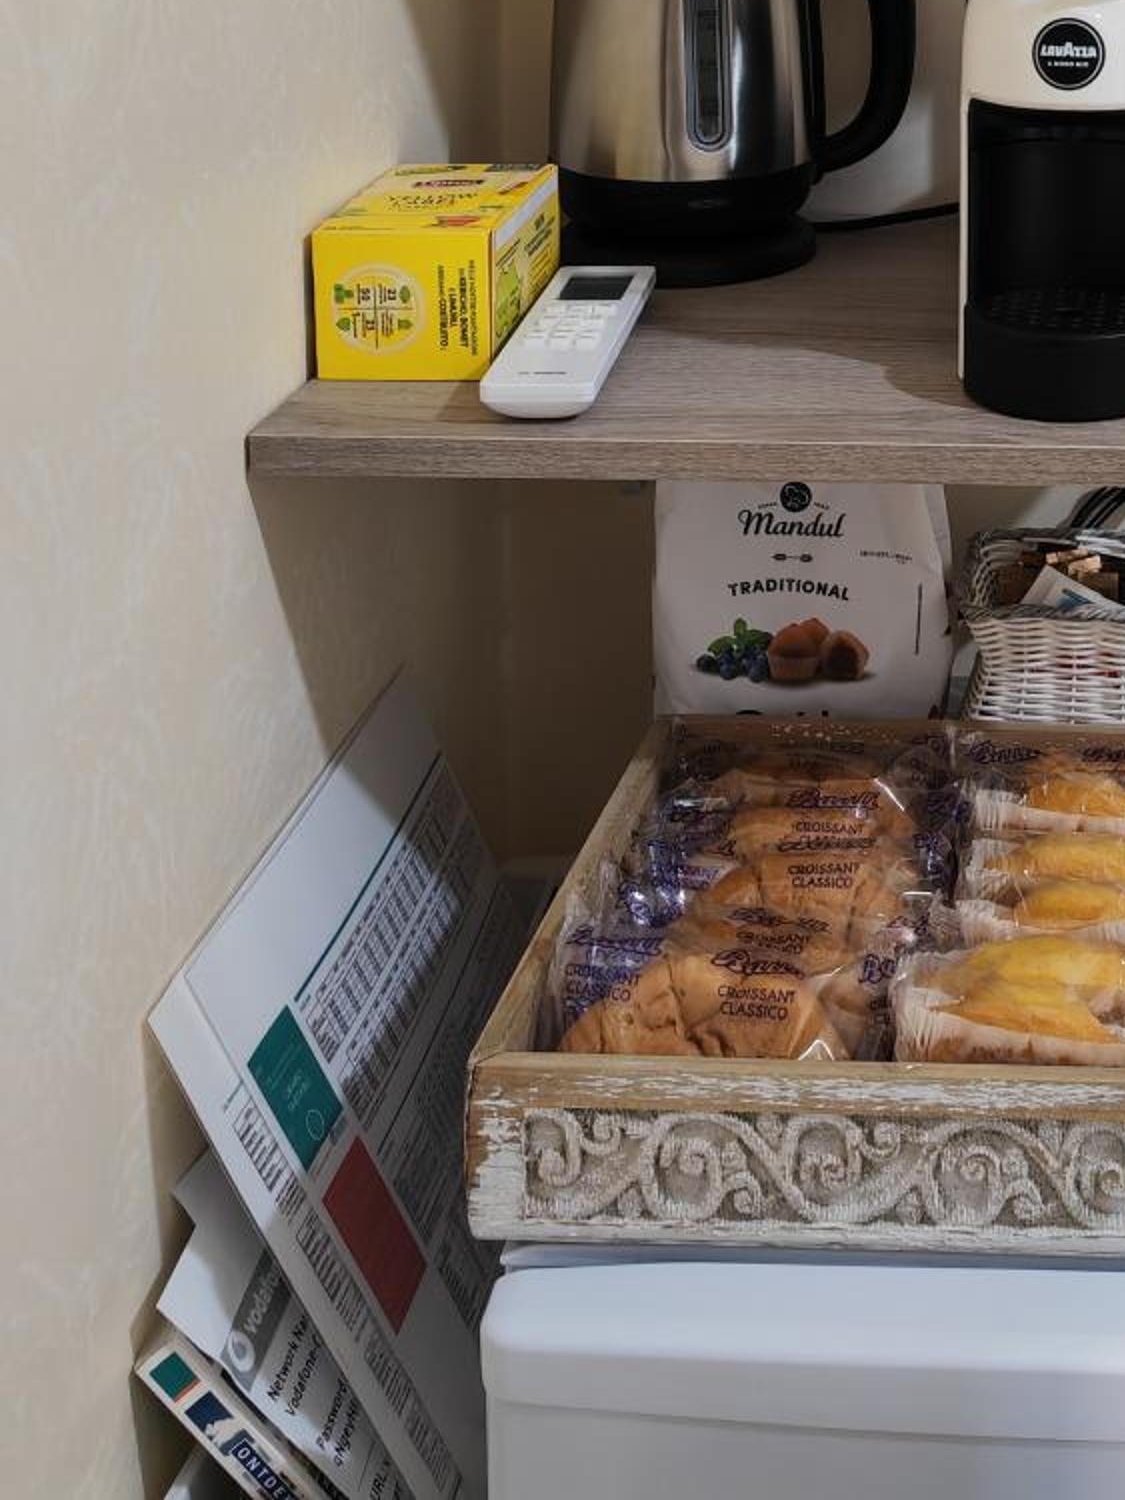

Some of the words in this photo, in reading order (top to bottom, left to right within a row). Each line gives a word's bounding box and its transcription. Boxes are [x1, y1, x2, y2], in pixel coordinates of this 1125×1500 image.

[1040, 41, 1097, 58] LAVAZZA
[738, 509, 847, 538] Mandul
[728, 577, 849, 601] TRADITIONAL
[793, 821, 864, 835] CROISSANT
[787, 862, 861, 875] CROISSANT
[791, 875, 852, 889] CLASSICO
[565, 963, 640, 987] CROISSANT
[717, 984, 796, 1004] CROISSANT
[719, 1001, 790, 1022] CLASSICO
[265, 1339, 300, 1402] Network
